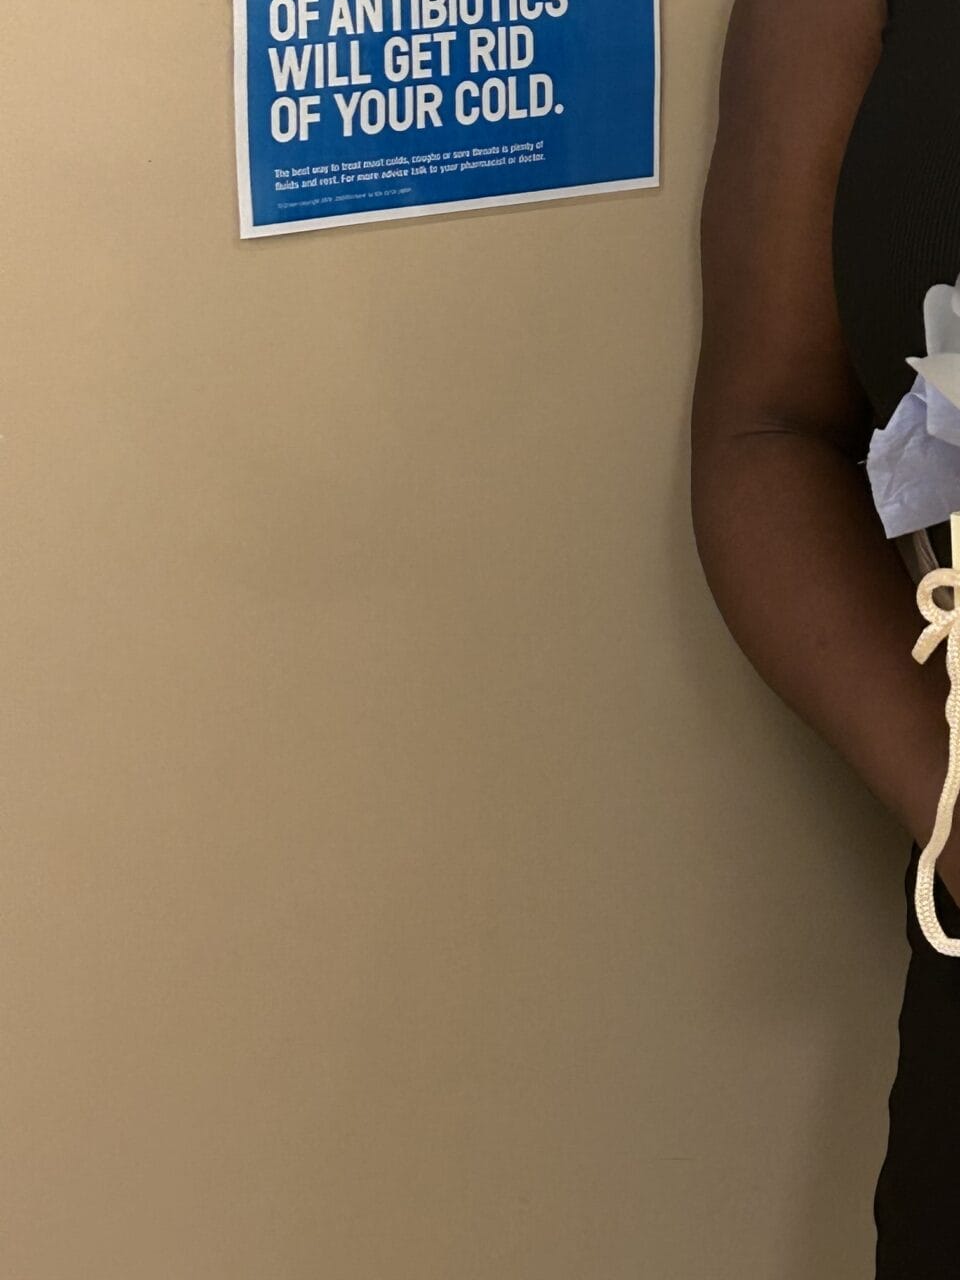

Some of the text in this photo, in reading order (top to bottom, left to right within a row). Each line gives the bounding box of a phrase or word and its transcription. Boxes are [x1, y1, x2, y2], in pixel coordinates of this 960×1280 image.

[268, 25, 535, 92] WILL GET RID
[270, 73, 565, 143] OF YOUR COLD.
[274, 168, 290, 178] The
